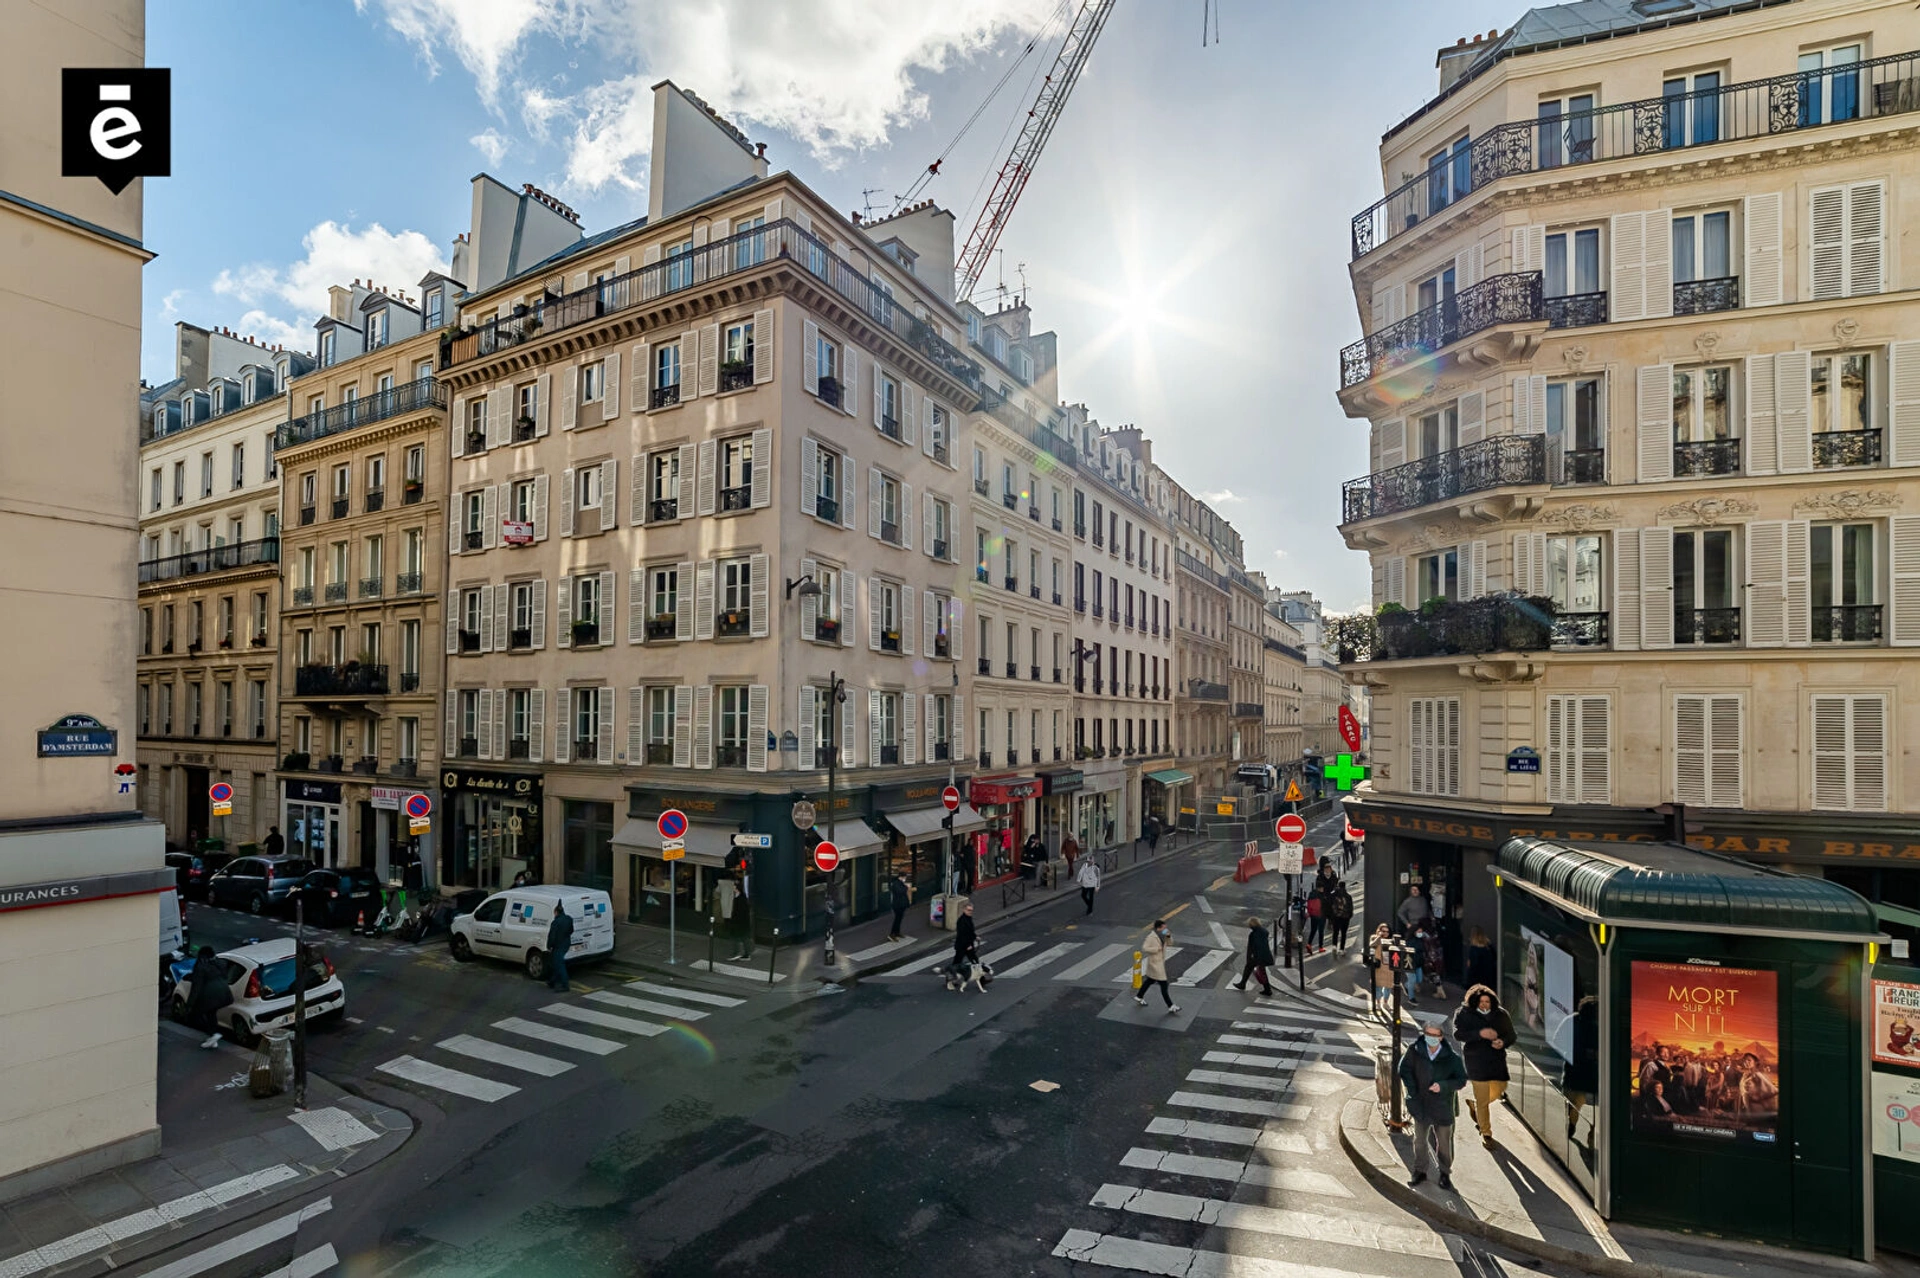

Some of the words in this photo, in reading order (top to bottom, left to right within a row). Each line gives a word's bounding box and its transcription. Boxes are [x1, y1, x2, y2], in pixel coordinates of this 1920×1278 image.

[1343, 714, 1356, 742] TABAC
[42, 743, 113, 752] D'AMSTERDAM
[1351, 811, 1388, 826] LE
[1393, 815, 1494, 841] LIEGE
[1686, 835, 1789, 854] BAR
[1822, 841, 1920, 859] BRA
[0, 885, 80, 904] URANCES
[1687, 958, 1721, 966] JCDecaux
[1668, 985, 1740, 1006] MORT
[1683, 1002, 1703, 1013] SUR
[1709, 1005, 1721, 1015] LE
[1675, 1012, 1734, 1036] NIL
[1892, 1107, 1904, 1119] 30
